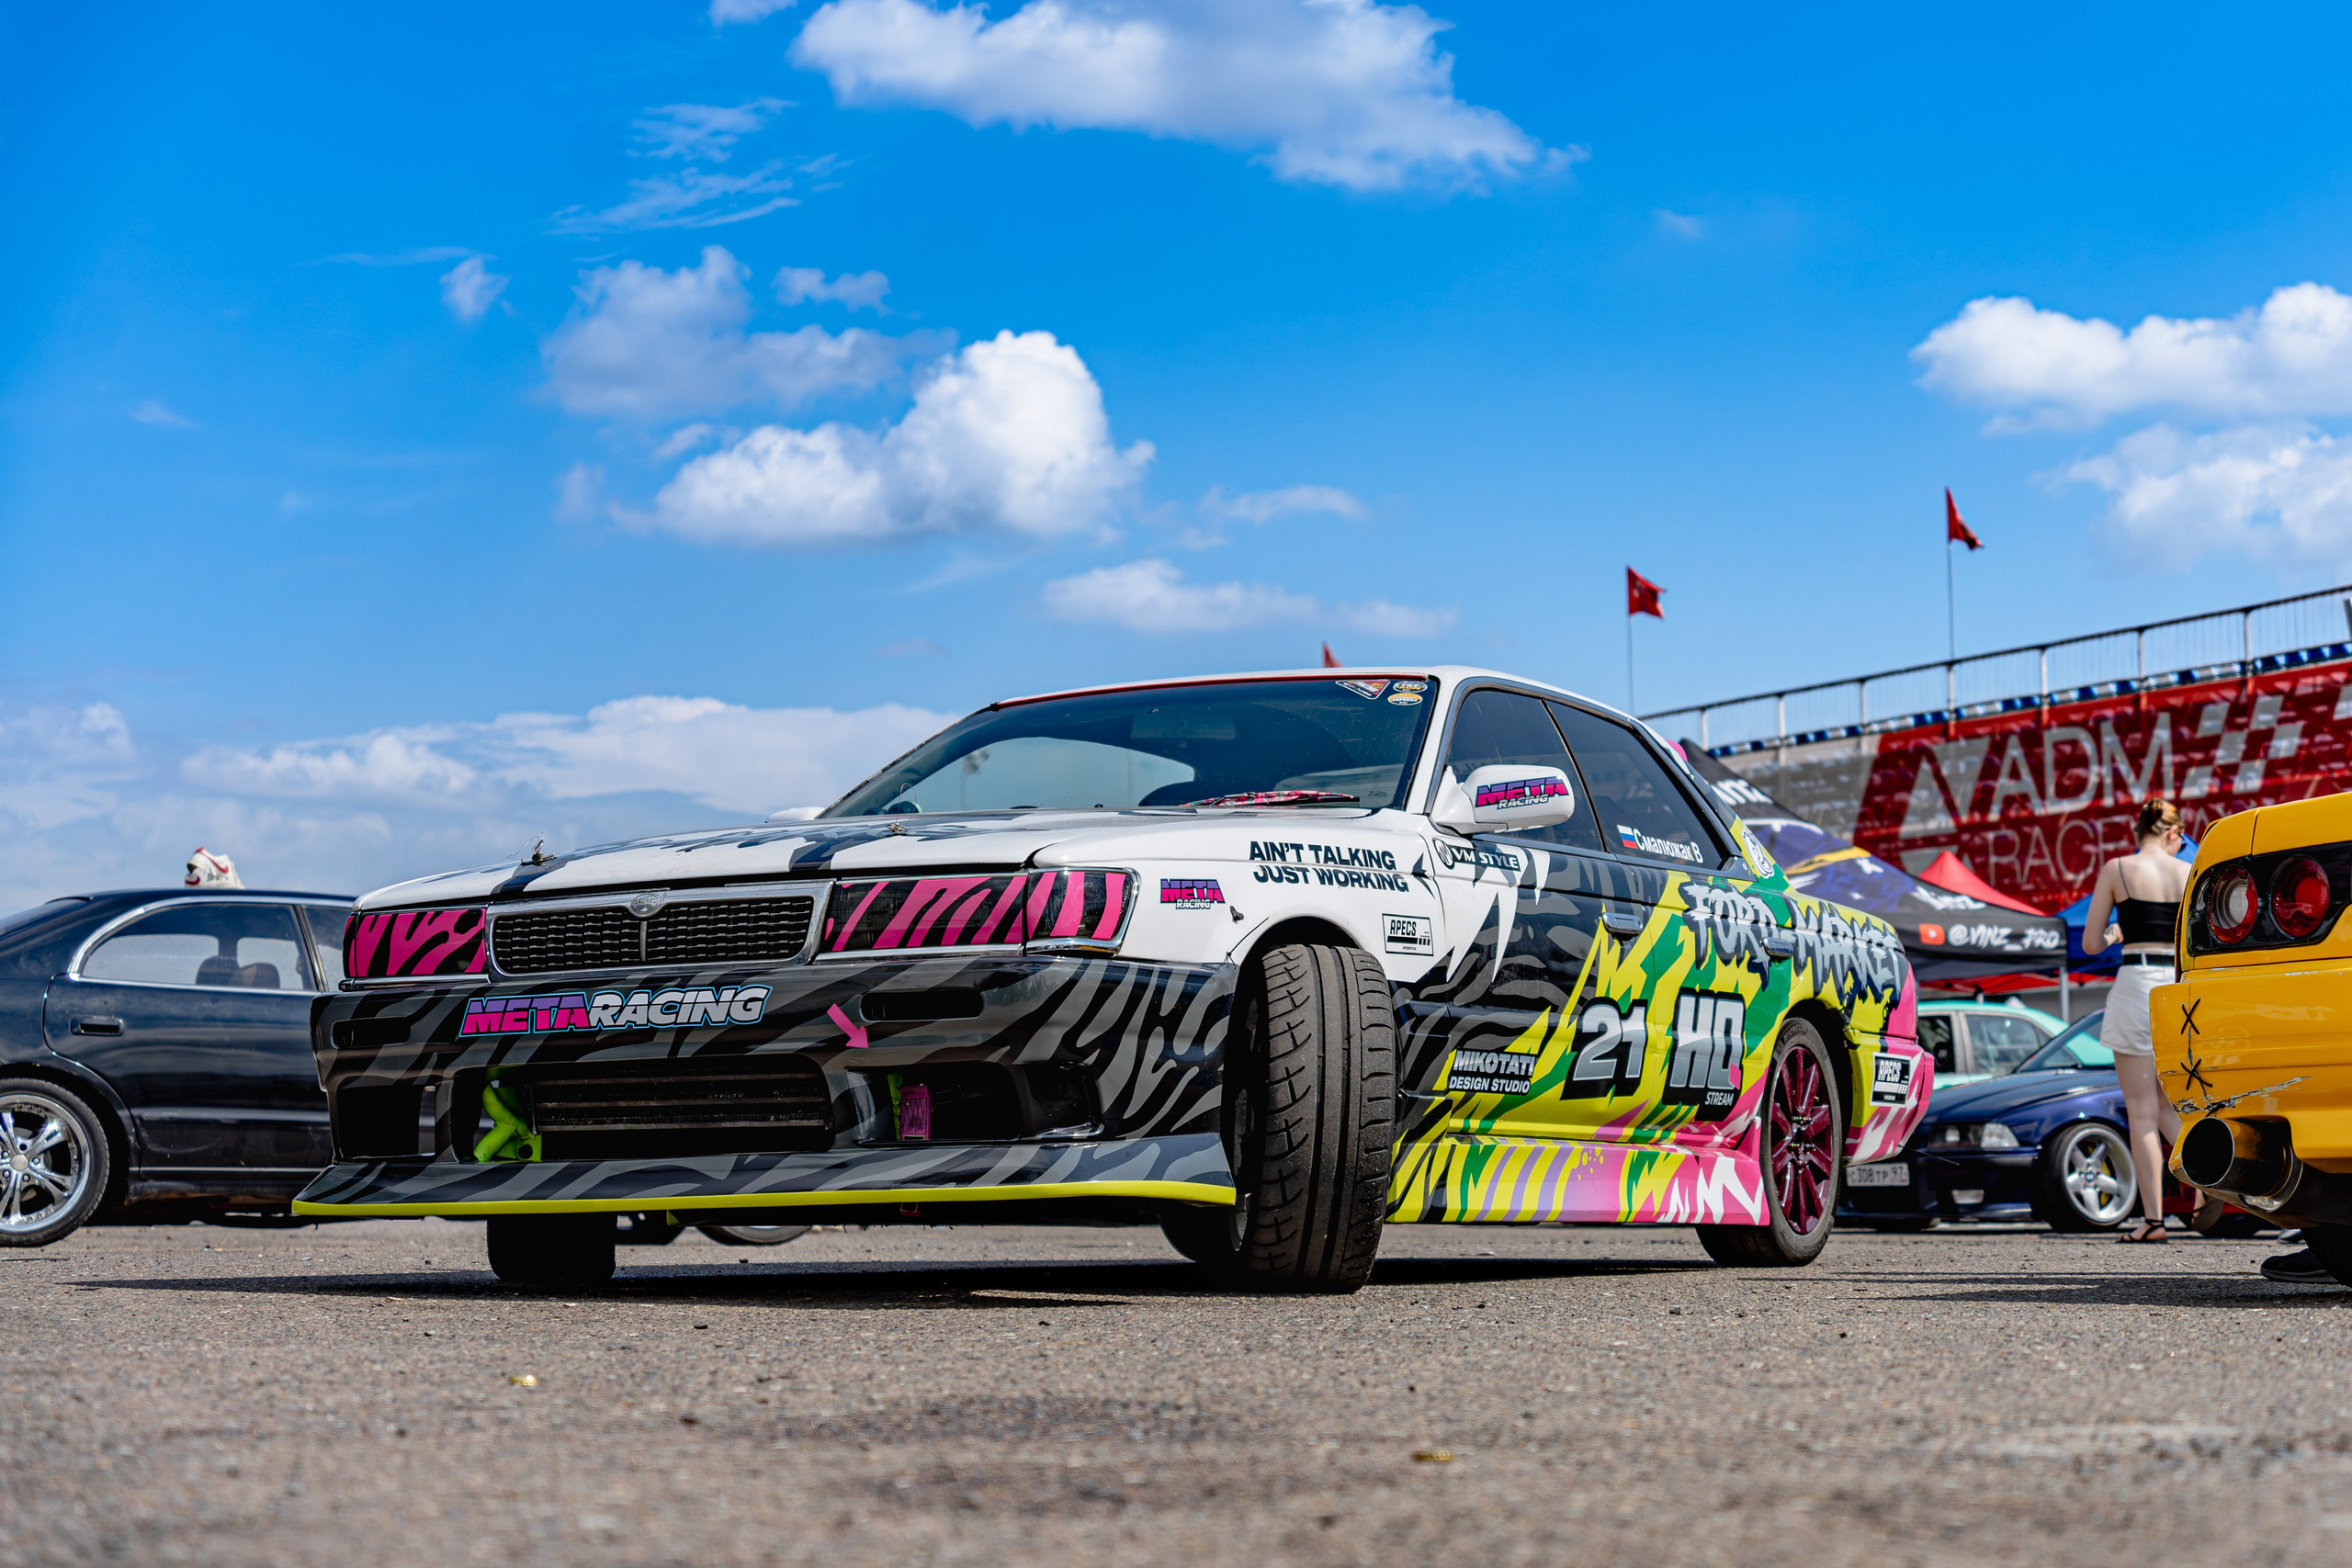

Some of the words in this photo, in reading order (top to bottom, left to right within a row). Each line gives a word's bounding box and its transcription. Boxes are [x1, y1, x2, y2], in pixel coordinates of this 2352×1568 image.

[1986, 712, 2176, 822] ADM
[1476, 776, 1569, 807] META
[1498, 794, 1549, 809] RACING
[1250, 840, 1304, 863] AIN'T
[1307, 843, 1397, 871] TALKING
[1633, 828, 1695, 862] Смалюжак
[1451, 847, 1476, 863] VM
[1478, 852, 1519, 869] STYLE
[1252, 865, 1310, 885] JUST
[1312, 867, 1409, 892] WORKING
[1160, 879, 1225, 903] META
[1176, 898, 1211, 908] RACING
[1389, 919, 1417, 937] APECS
[1572, 1004, 1645, 1081] 21
[1453, 1050, 1536, 1077] MIKOTATI
[1877, 1060, 1902, 1082] APECS
[1448, 1076, 1490, 1091] DESIGN
[1490, 1077, 1531, 1094] STUDIO
[1704, 1091, 1735, 1106] STREAM
